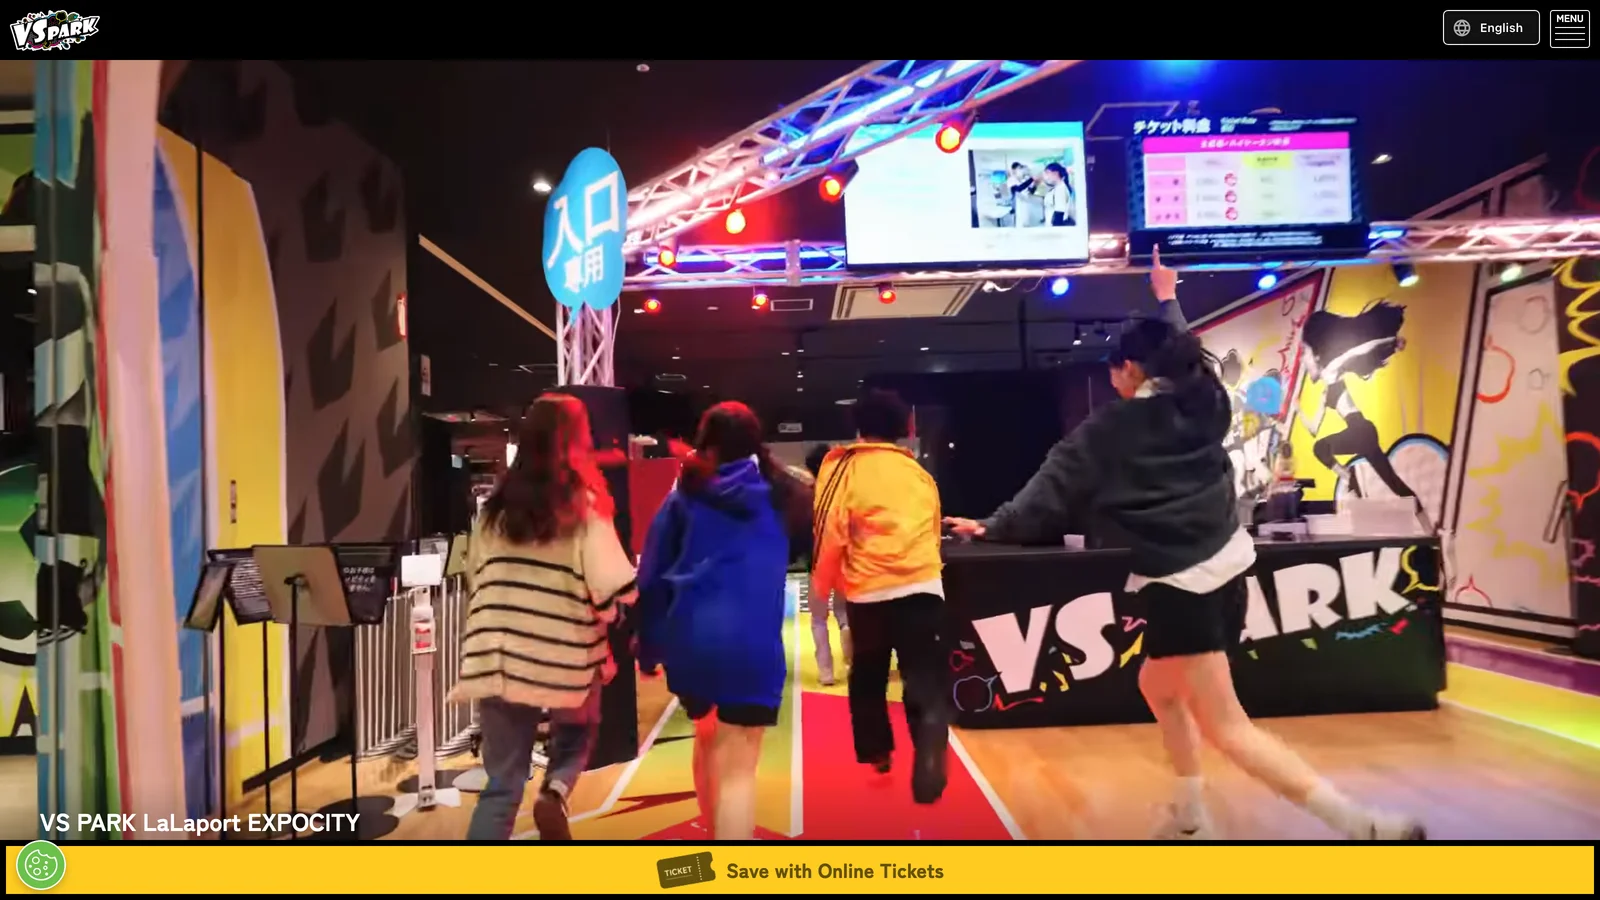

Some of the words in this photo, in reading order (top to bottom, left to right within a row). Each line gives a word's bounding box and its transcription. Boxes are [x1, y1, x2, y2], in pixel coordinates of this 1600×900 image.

[547, 170, 620, 269] 入口
[972, 592, 1117, 694] VS
[1239, 547, 1411, 643] ARK
